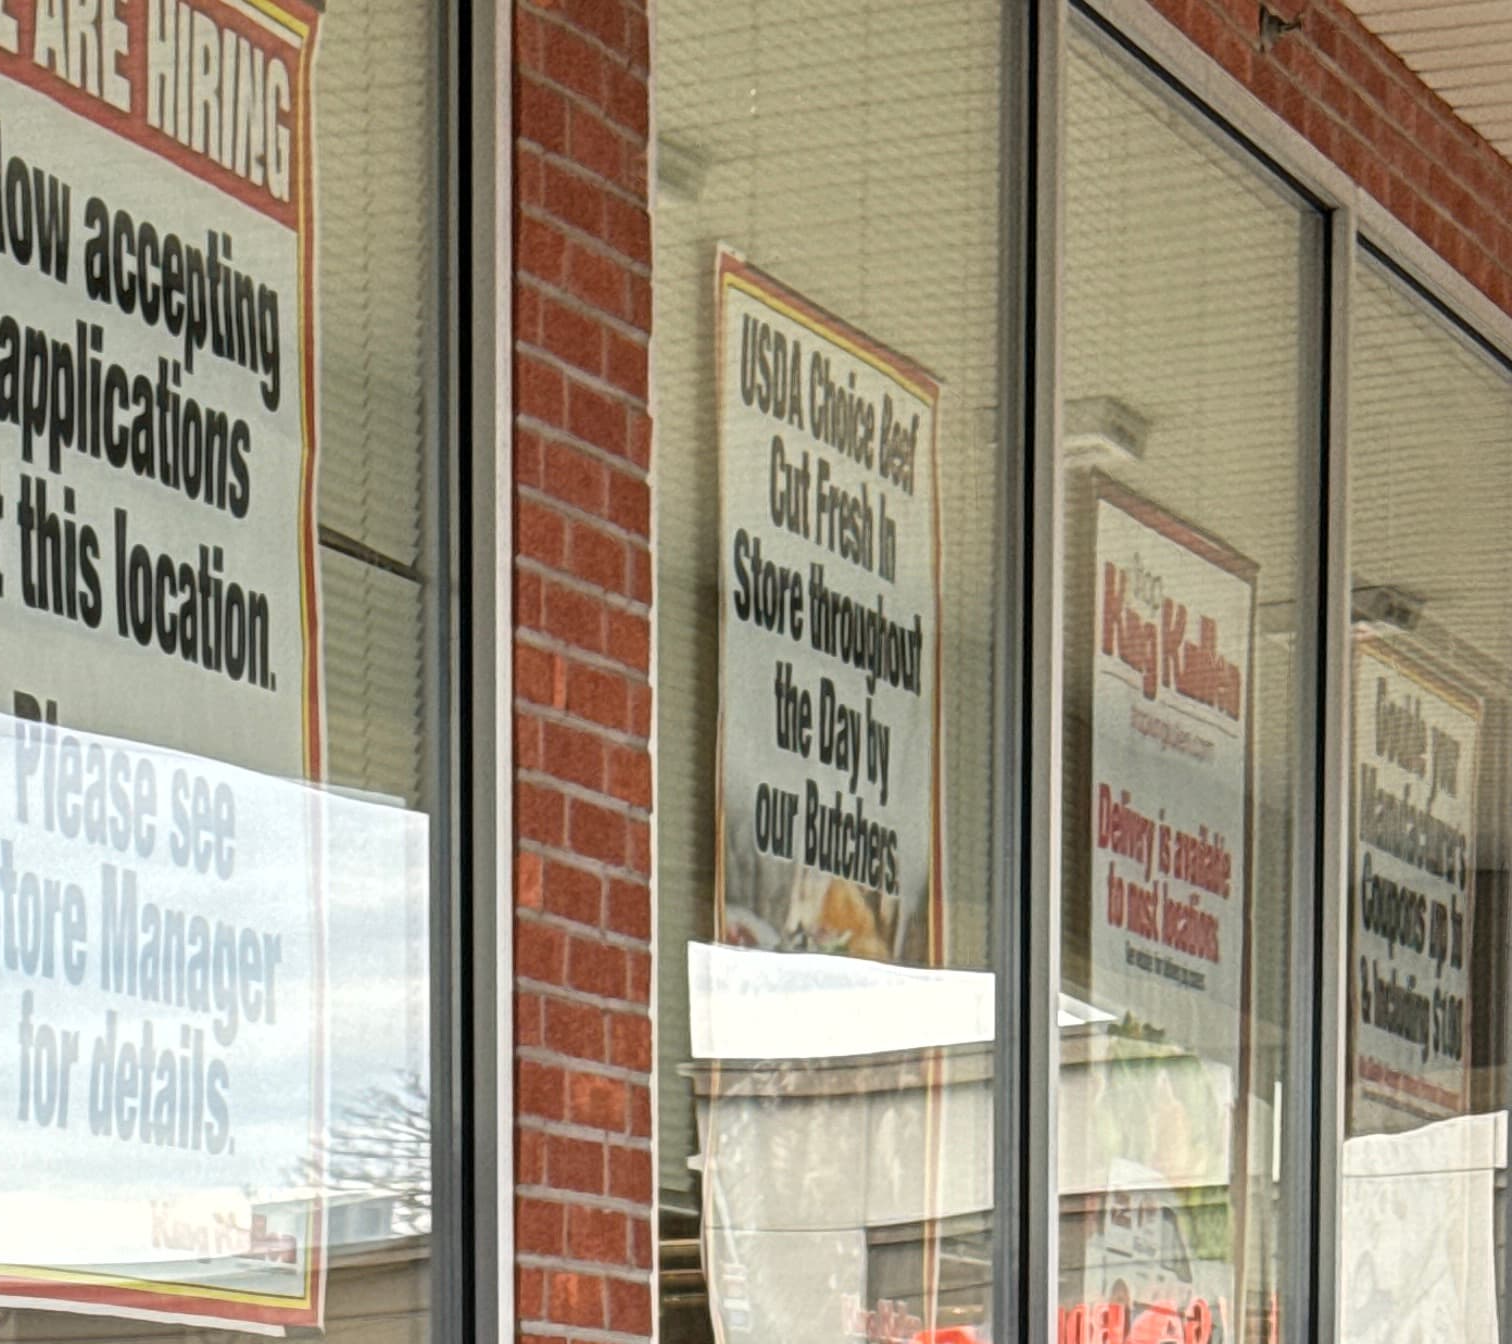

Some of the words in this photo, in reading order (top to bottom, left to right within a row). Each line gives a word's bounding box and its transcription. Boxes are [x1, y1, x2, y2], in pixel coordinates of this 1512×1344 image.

[148, 0, 291, 203] HIRING
[84, 197, 281, 412] accepting
[740, 313, 804, 431] USDA
[809, 350, 875, 470] Choice
[18, 473, 103, 628] this
[115, 507, 277, 692] location.
[770, 435, 810, 540] Cut
[816, 457, 874, 573] Fresh
[733, 527, 805, 641] Store
[808, 562, 922, 696] throughout
[13, 690, 158, 858] Please
[169, 768, 236, 880] see
[774, 660, 813, 758] the
[818, 676, 861, 794] Day
[866, 697, 890, 806] by
[755, 782, 799, 860] our
[1108, 860, 1125, 928] to
[1158, 808, 1173, 875] is
[101, 863, 283, 1046] Manager
[17, 991, 79, 1128] for
[89, 1010, 235, 1155] details.
